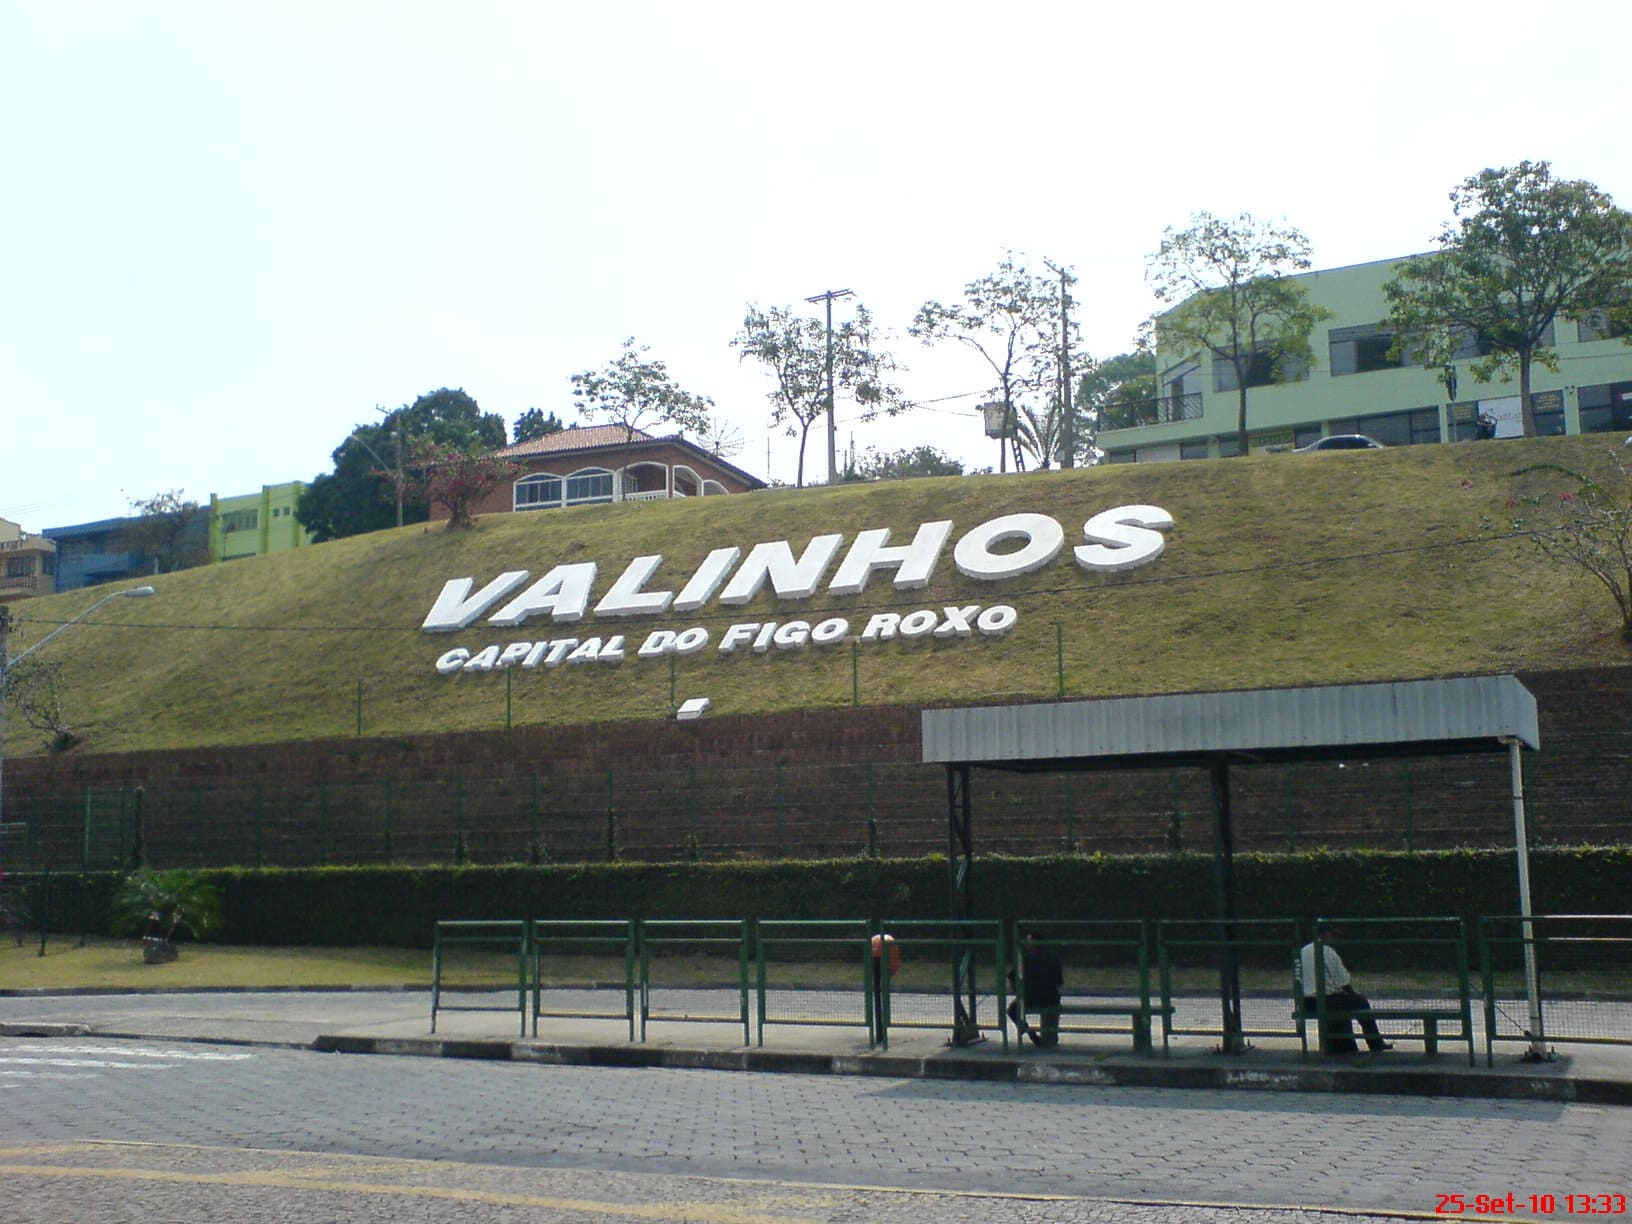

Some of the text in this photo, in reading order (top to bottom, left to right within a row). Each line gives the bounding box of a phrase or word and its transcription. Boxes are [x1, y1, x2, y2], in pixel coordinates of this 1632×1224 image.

[422, 504, 1174, 632] VALINHOS
[435, 604, 1017, 674] CAPITAL DO FIGO ROXO
